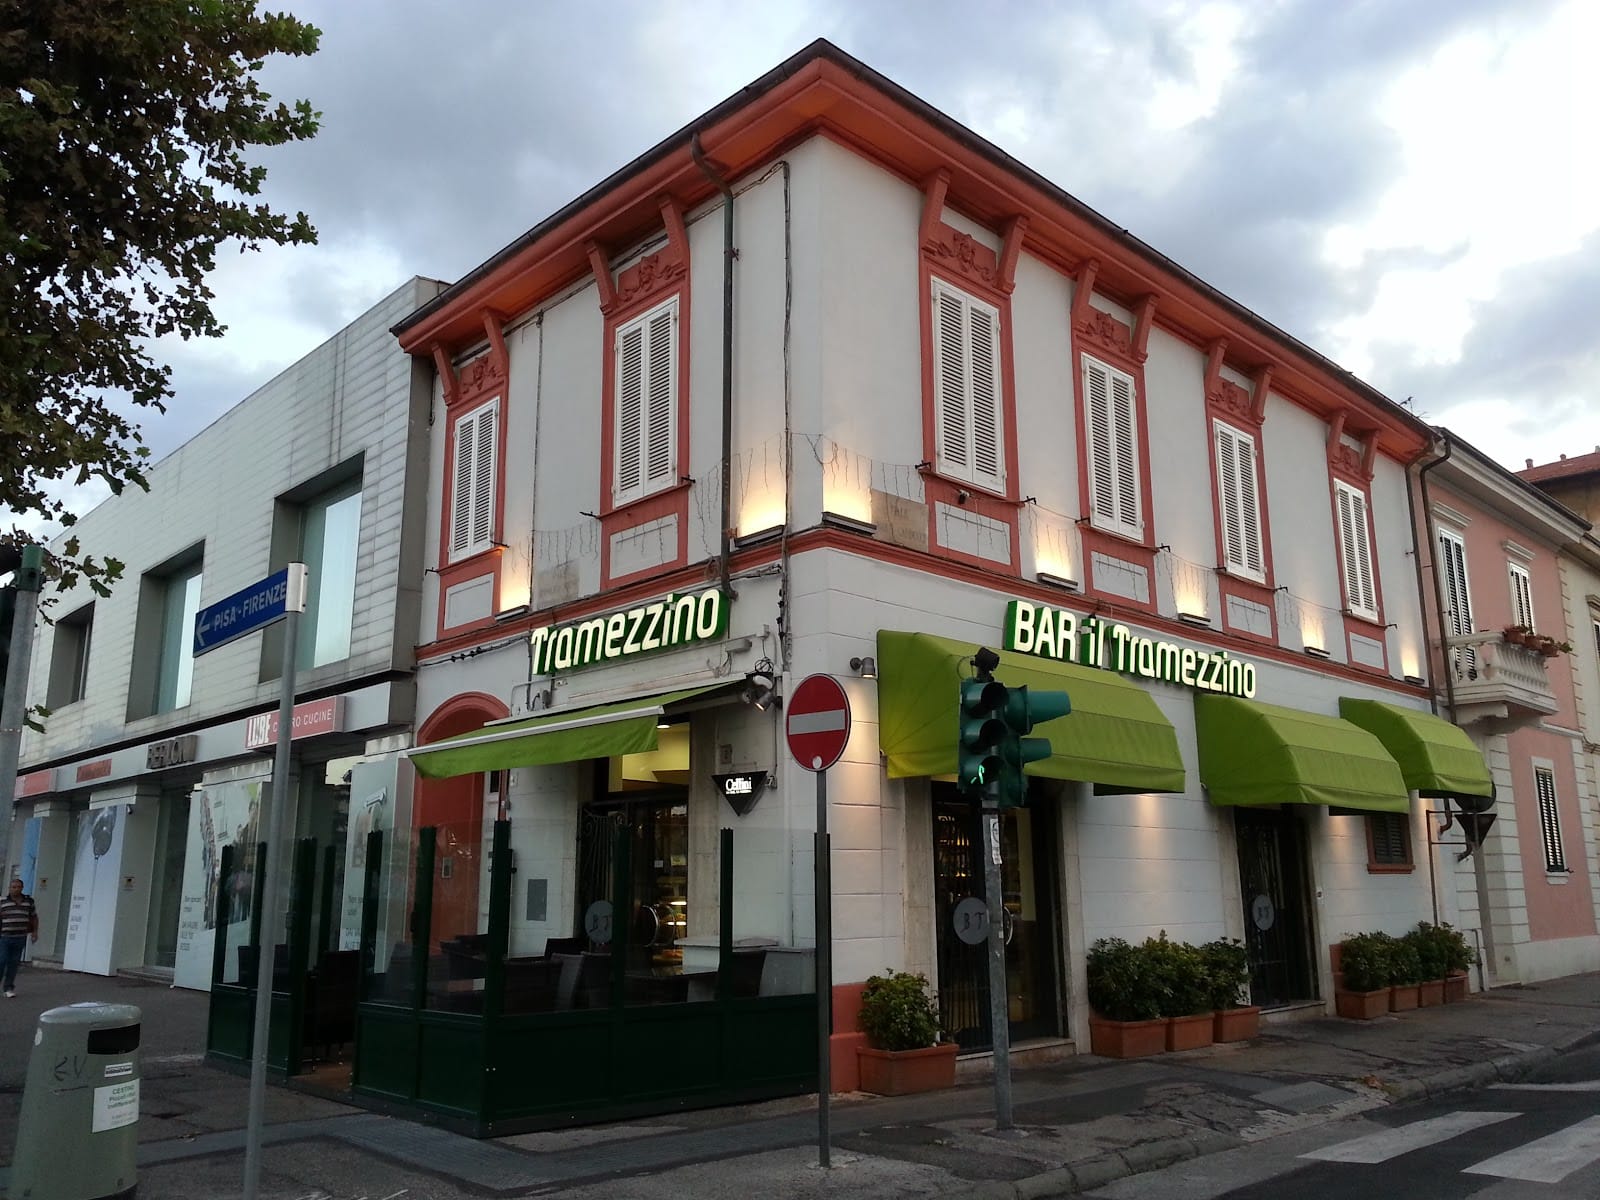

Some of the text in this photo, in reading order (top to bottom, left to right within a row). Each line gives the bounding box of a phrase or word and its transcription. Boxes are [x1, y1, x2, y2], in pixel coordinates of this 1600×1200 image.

[531, 588, 721, 675] Tramezzino
[1012, 600, 1256, 699] BAR il Tramezzino
[303, 708, 333, 726] CUCINE
